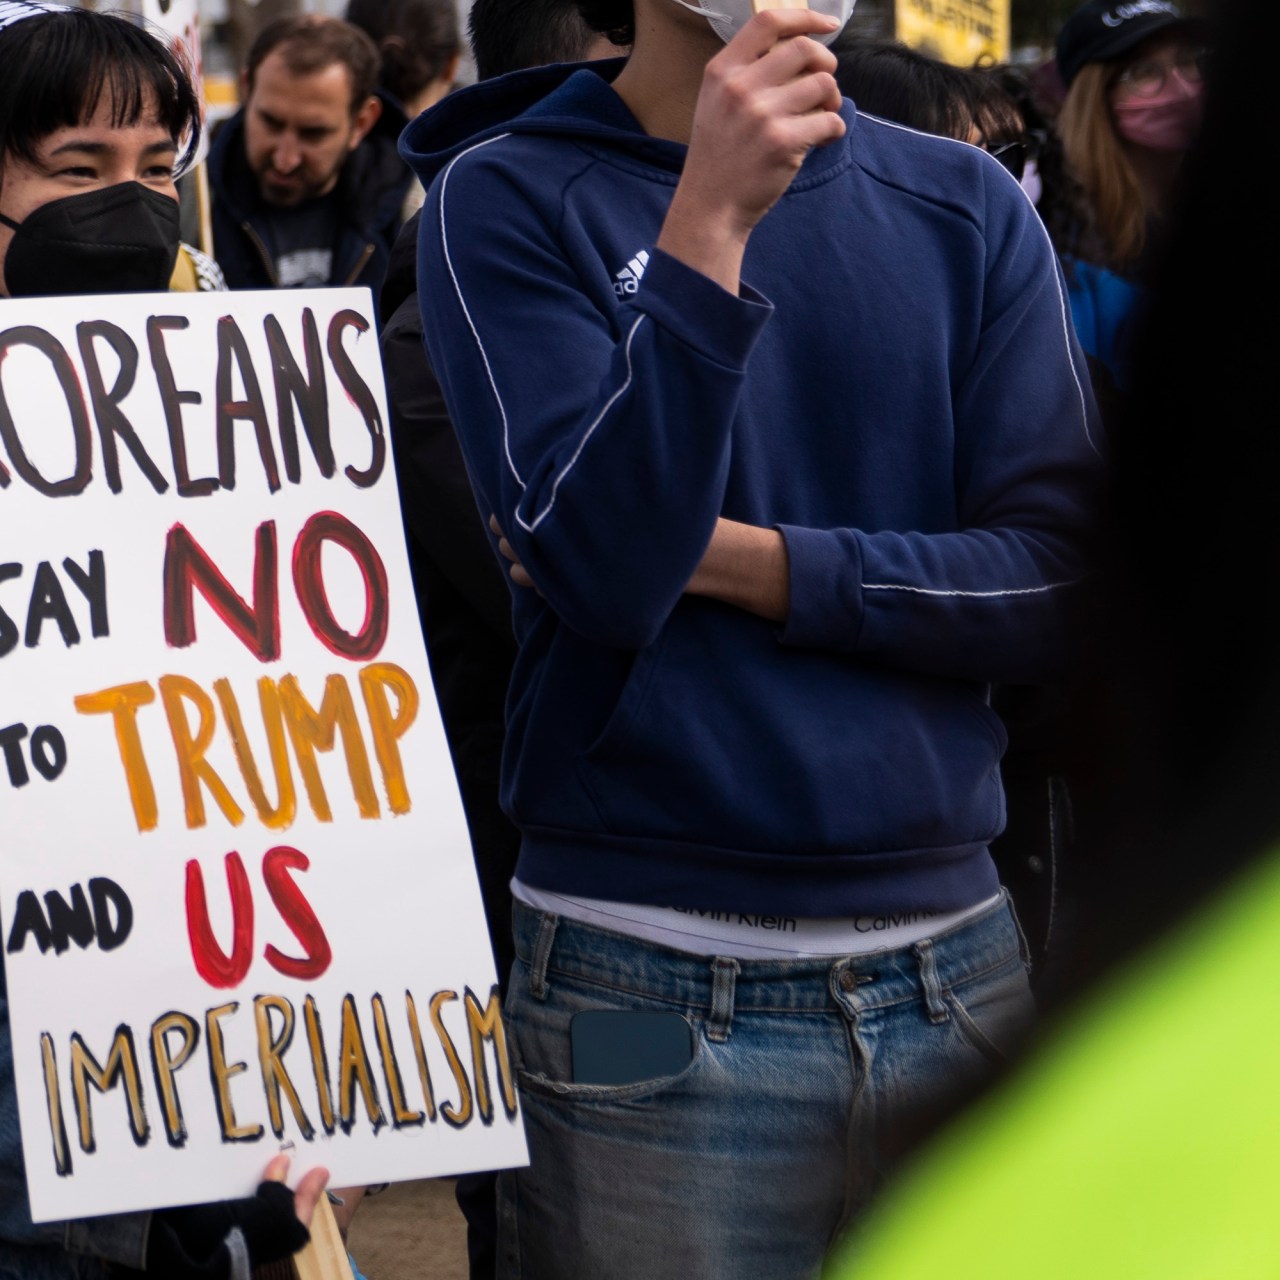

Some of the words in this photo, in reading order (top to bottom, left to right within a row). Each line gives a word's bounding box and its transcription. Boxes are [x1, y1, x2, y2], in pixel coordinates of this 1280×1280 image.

[162, 510, 390, 663] NO
[73, 661, 420, 833] TRUMP
[6, 876, 133, 957] AND
[183, 845, 333, 990] US
[40, 983, 519, 1179] IMPERIALISM
